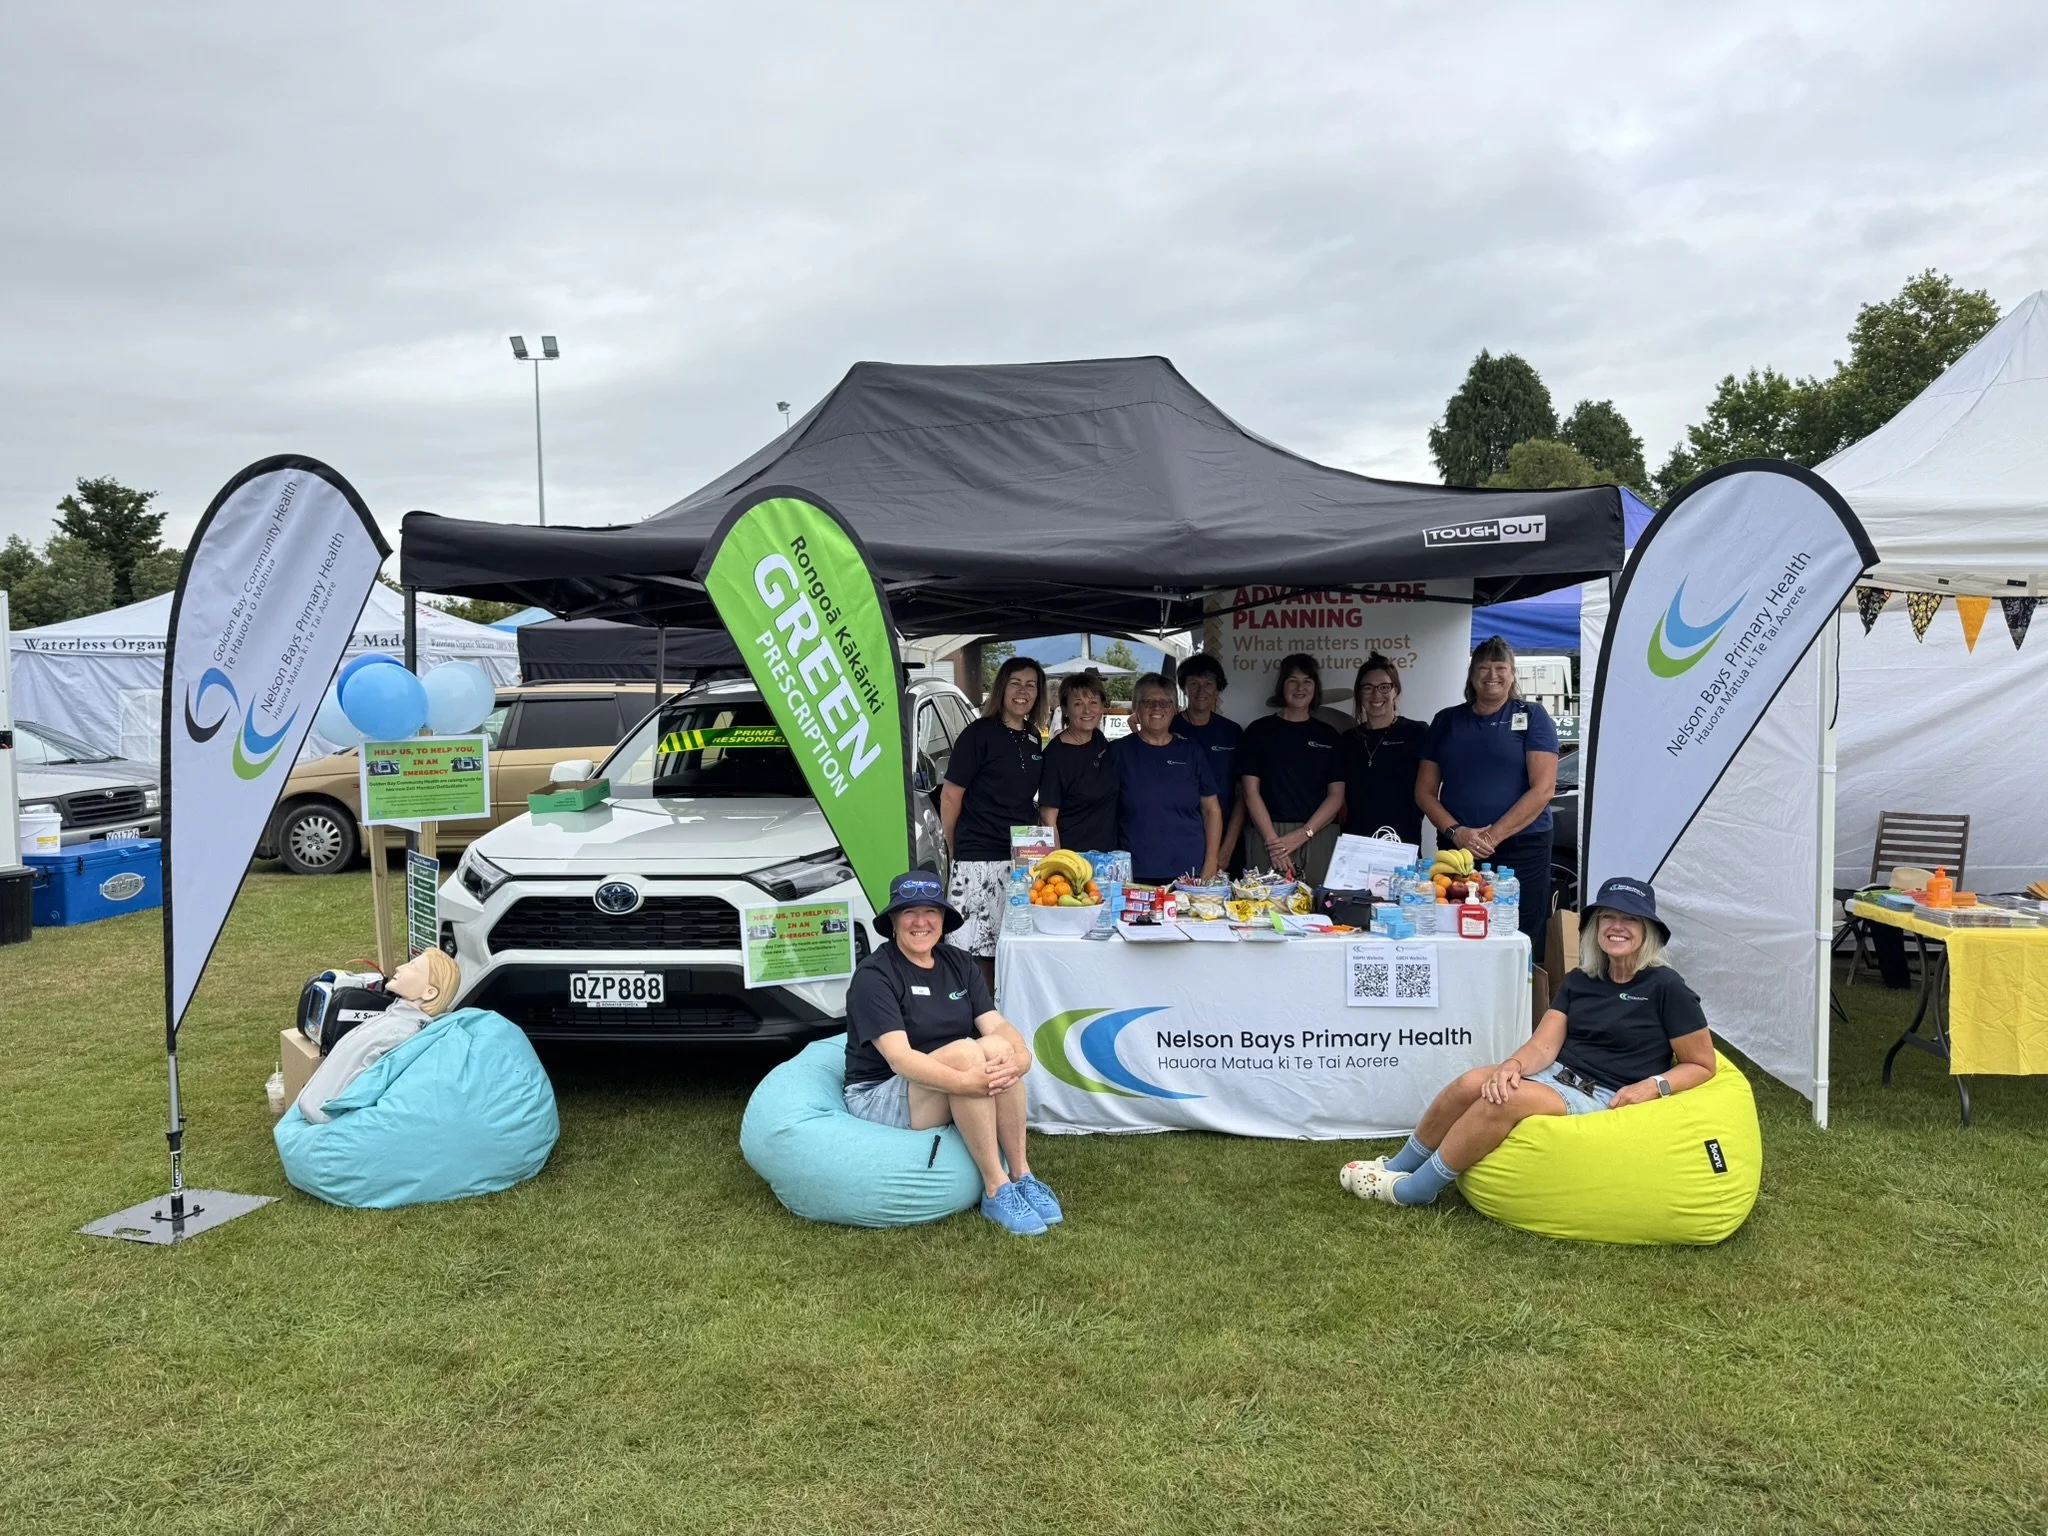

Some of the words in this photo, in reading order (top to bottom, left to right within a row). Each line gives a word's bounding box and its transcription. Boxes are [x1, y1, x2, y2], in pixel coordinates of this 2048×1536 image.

[213, 619, 237, 662] Golden
[232, 595, 248, 617] Bay
[243, 523, 281, 593] Community
[272, 481, 298, 522] Health
[253, 559, 275, 600] Mohua
[319, 581, 337, 614] Aorere
[1360, 582, 1427, 604] CARE
[250, 602, 257, 611] o
[260, 667, 287, 713] Nelson
[281, 634, 301, 666] Bays
[295, 580, 326, 632] Primary
[318, 532, 345, 579] Health
[311, 616, 322, 631] Tai
[790, 535, 842, 625] Rongoā
[834, 625, 885, 715] Kākāriki
[1233, 608, 1363, 630] PLANNING
[23, 637, 106, 651] Waterless
[112, 637, 168, 652] Organ
[363, 634, 406, 647] Mad
[231, 613, 253, 655] Hauora
[305, 631, 315, 643] Te
[1233, 635, 1283, 651] What
[1288, 636, 1359, 651] matters
[1364, 634, 1411, 650] most
[301, 645, 310, 655] ki
[1666, 706, 1707, 757] Nelson
[1700, 667, 1731, 705] Bays
[1724, 607, 1773, 667] Primary
[1765, 552, 1812, 606] Health
[223, 656, 236, 671] Te
[287, 656, 305, 686] Matua
[753, 552, 882, 780] GREEN
[1233, 654, 1257, 671] for
[1263, 657, 1281, 674] yo
[1318, 655, 1363, 670] uture
[1388, 652, 1418, 669] re?
[1695, 705, 1725, 745] Hauora
[1720, 669, 1750, 705] Matua
[1744, 656, 1758, 669] ki
[1752, 642, 1768, 657] Te
[1761, 624, 1780, 641] Tai
[1775, 585, 1807, 626] Aorere
[272, 687, 291, 720] Hauora
[755, 629, 849, 799] PRESCRIPTION
[403, 769, 448, 777] EMERGENCY
[779, 931, 819, 939] EMERGENCY
[573, 977, 661, 1000] QZP888
[1157, 1030, 1233, 1048] Nelson
[1241, 1031, 1295, 1054] Bays
[1302, 1029, 1392, 1052] Primary
[1399, 1027, 1472, 1046] Health
[1158, 1056, 1216, 1070] Hauora
[1222, 1056, 1273, 1070] Matua
[1278, 1055, 1290, 1070] ki
[1294, 1056, 1313, 1070] Te
[1317, 1055, 1341, 1069] Tai
[1345, 1055, 1399, 1069] Aorere
[1709, 1143, 1723, 1168] Beanz
